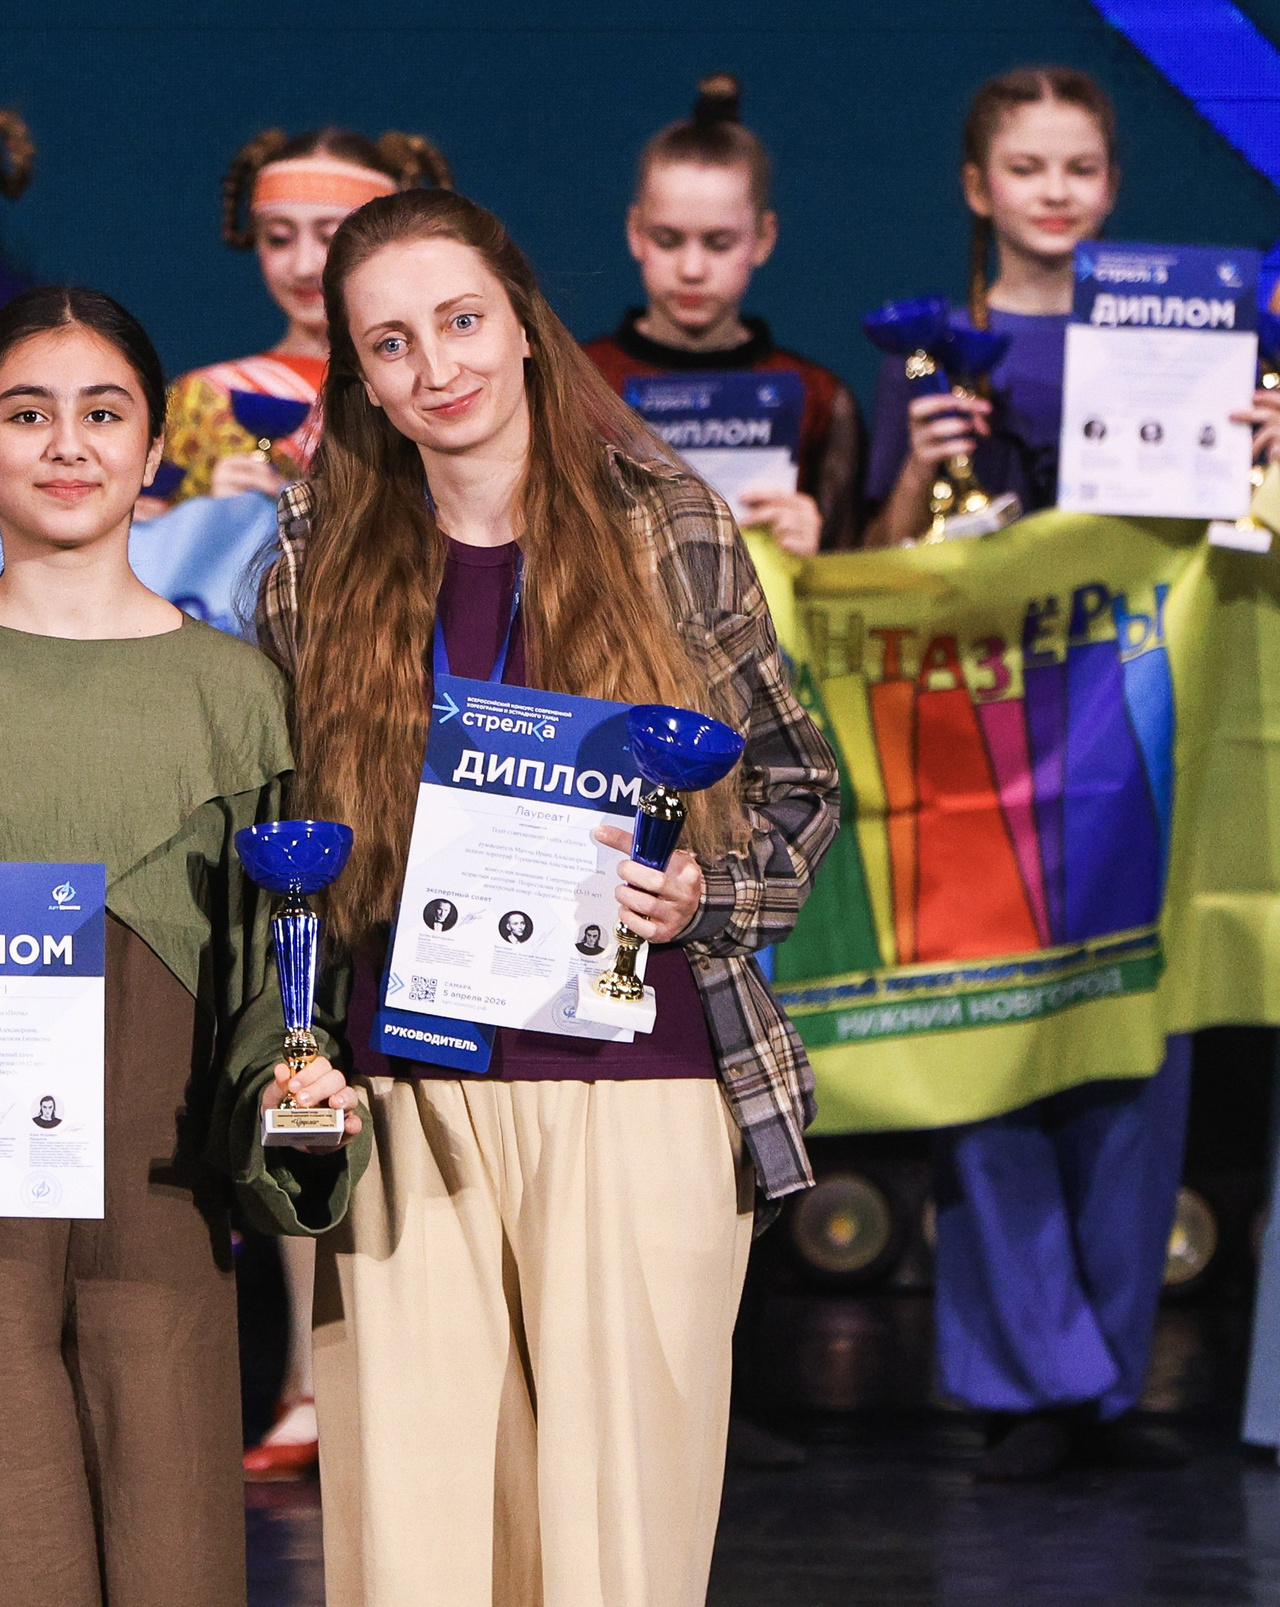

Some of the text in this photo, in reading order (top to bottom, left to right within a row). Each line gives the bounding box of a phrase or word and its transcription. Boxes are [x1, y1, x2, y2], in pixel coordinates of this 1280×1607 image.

[1090, 293, 1237, 329] ДИПЛОМ
[652, 417, 771, 447] ИПЛОМ
[778, 582, 1170, 720] АНТАЗЁРЫ
[462, 711, 556, 742] стрелка
[452, 749, 643, 806] ДИПЛОМ
[515, 805, 564, 822] Лауреат
[426, 887, 492, 902] экспертный совет
[444, 980, 472, 990] САМАРА
[450, 991, 482, 1004] апреля
[484, 995, 507, 1006] 2026
[835, 996, 962, 1040] НИЖНИЙ
[968, 966, 1124, 1023] НОВГОРОД
[384, 1024, 478, 1051] РУКОВОДИТЕЛЬ
